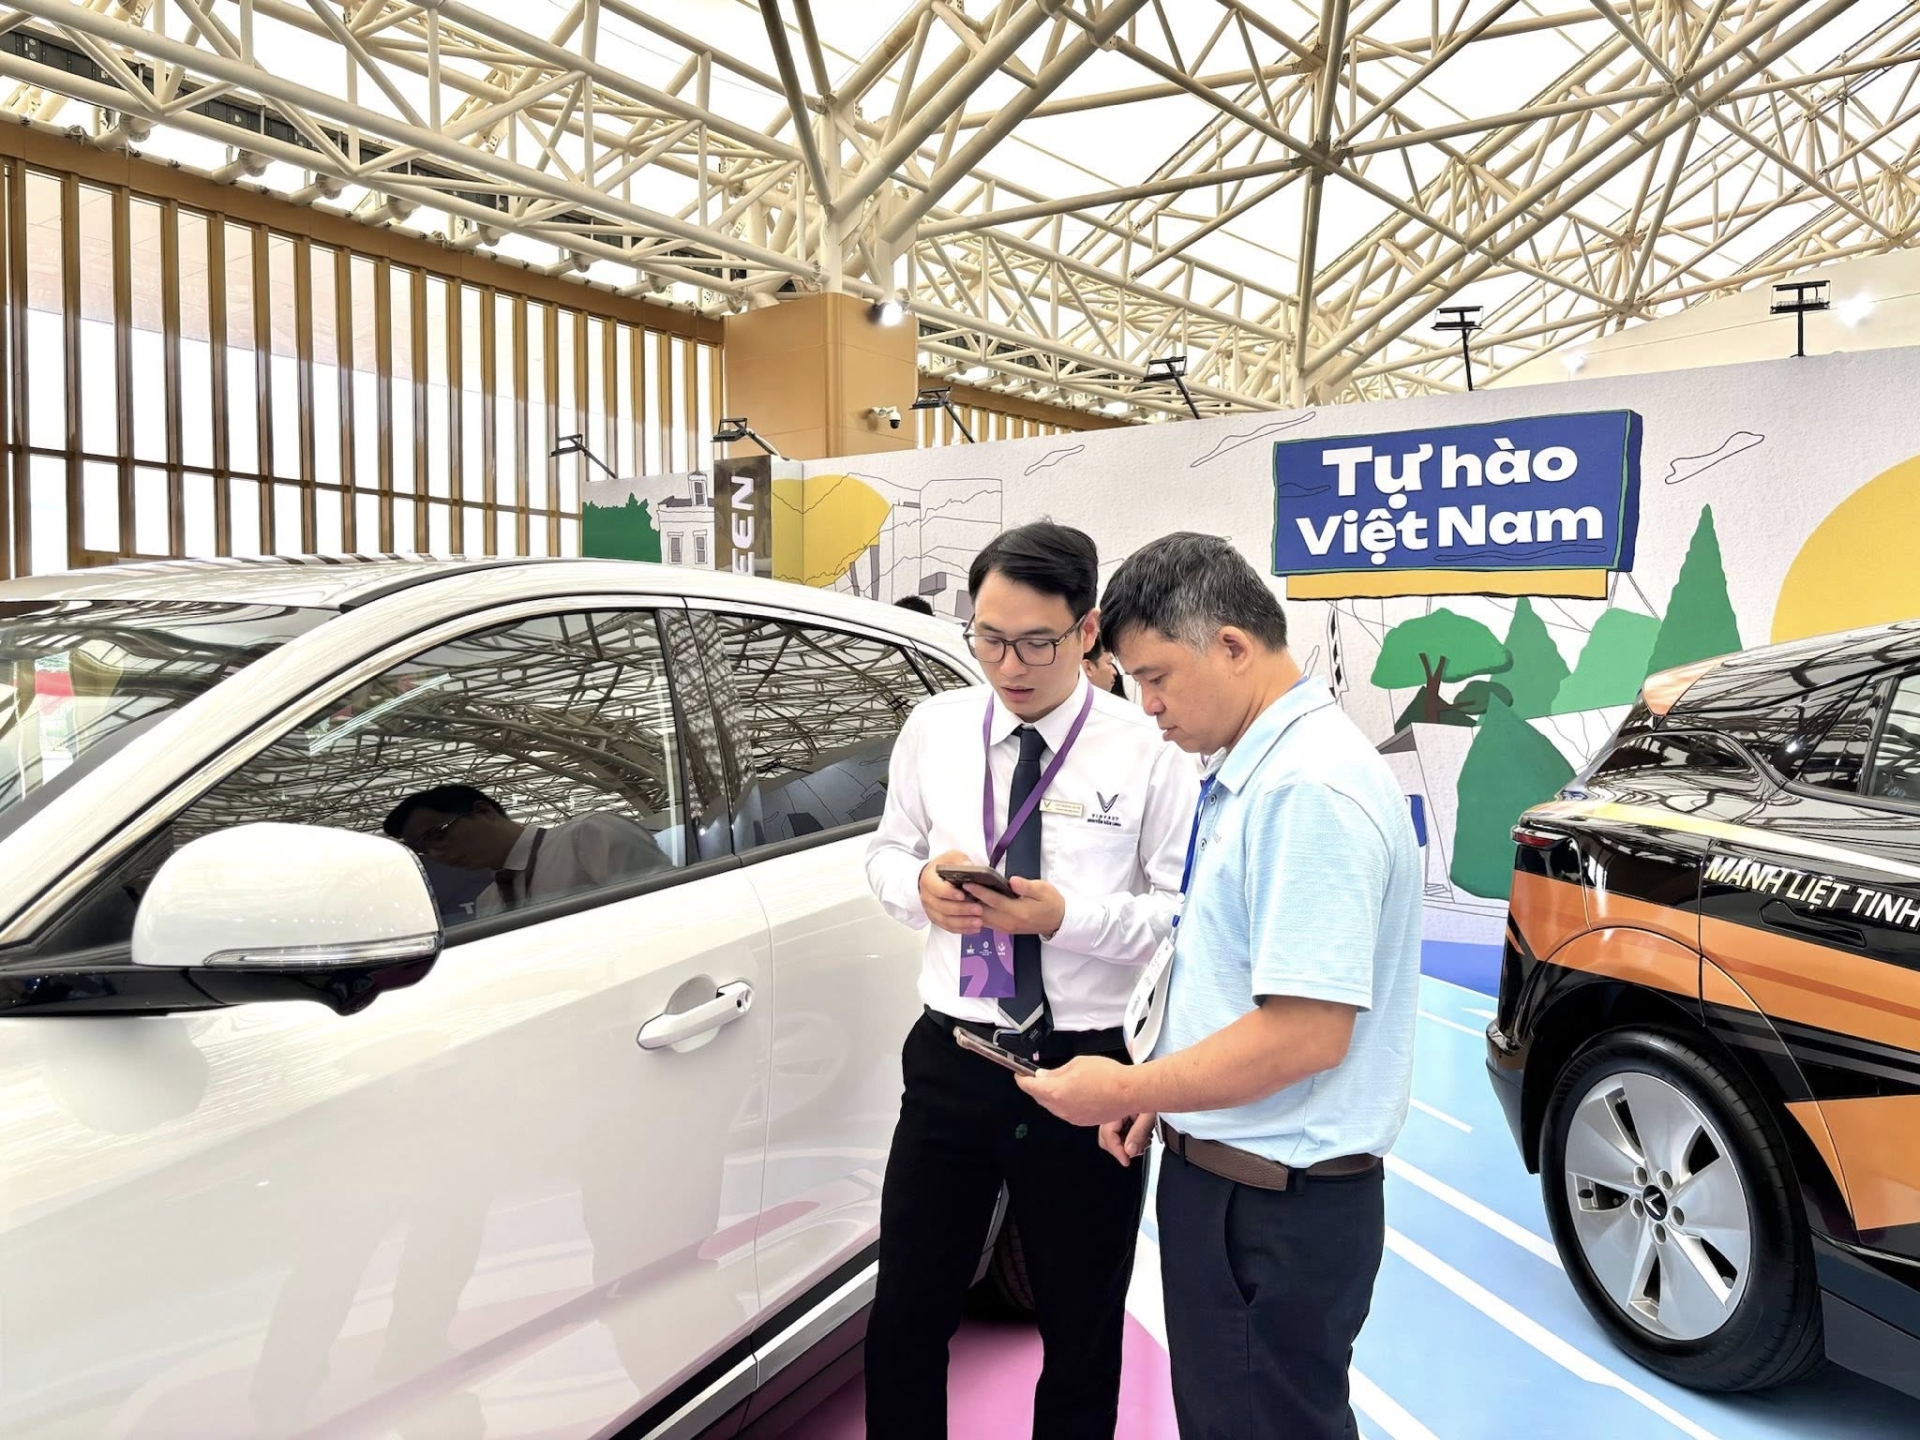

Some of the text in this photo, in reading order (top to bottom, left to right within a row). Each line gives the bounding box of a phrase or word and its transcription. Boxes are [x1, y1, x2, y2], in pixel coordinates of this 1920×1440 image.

[1322, 438, 1579, 510] Tự hào
[1295, 504, 1604, 566] Việt Nam
[1786, 870, 1851, 911] LIỆT
[1851, 886, 1920, 928] TINH
